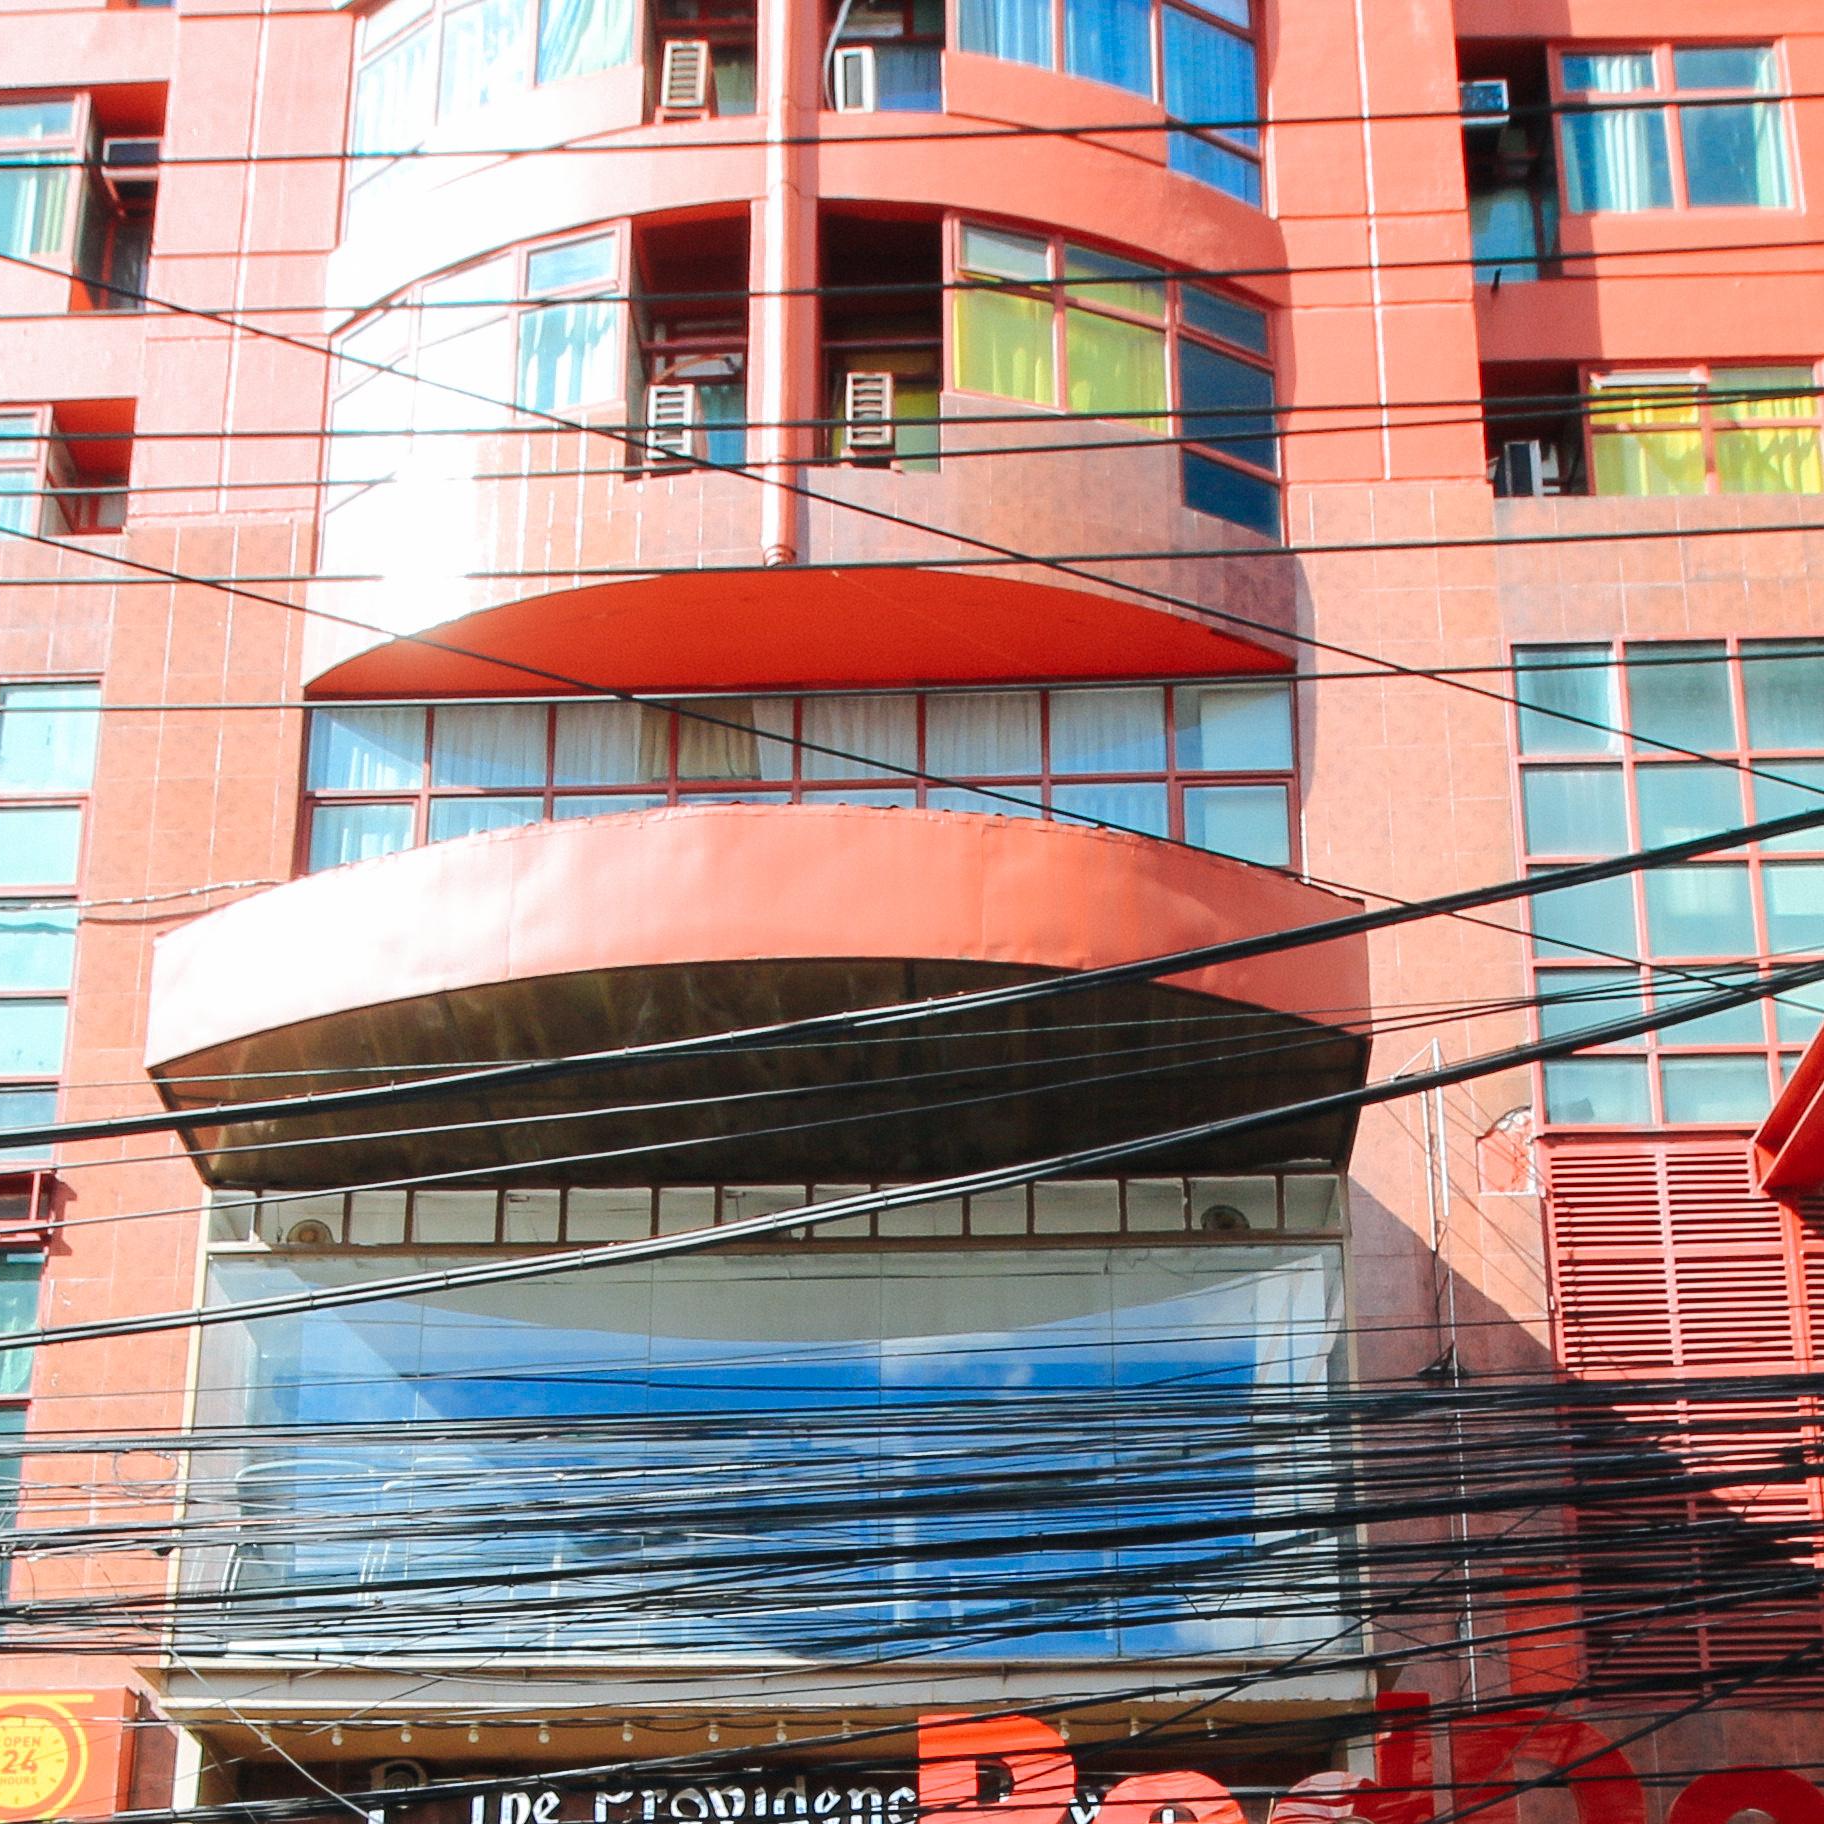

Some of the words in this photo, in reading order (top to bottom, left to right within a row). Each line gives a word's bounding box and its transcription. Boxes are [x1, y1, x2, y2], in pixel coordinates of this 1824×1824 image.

[3, 1735, 42, 1749] OPEN
[1, 1748, 38, 1776] 24
[0, 1775, 38, 1787] HOURS
